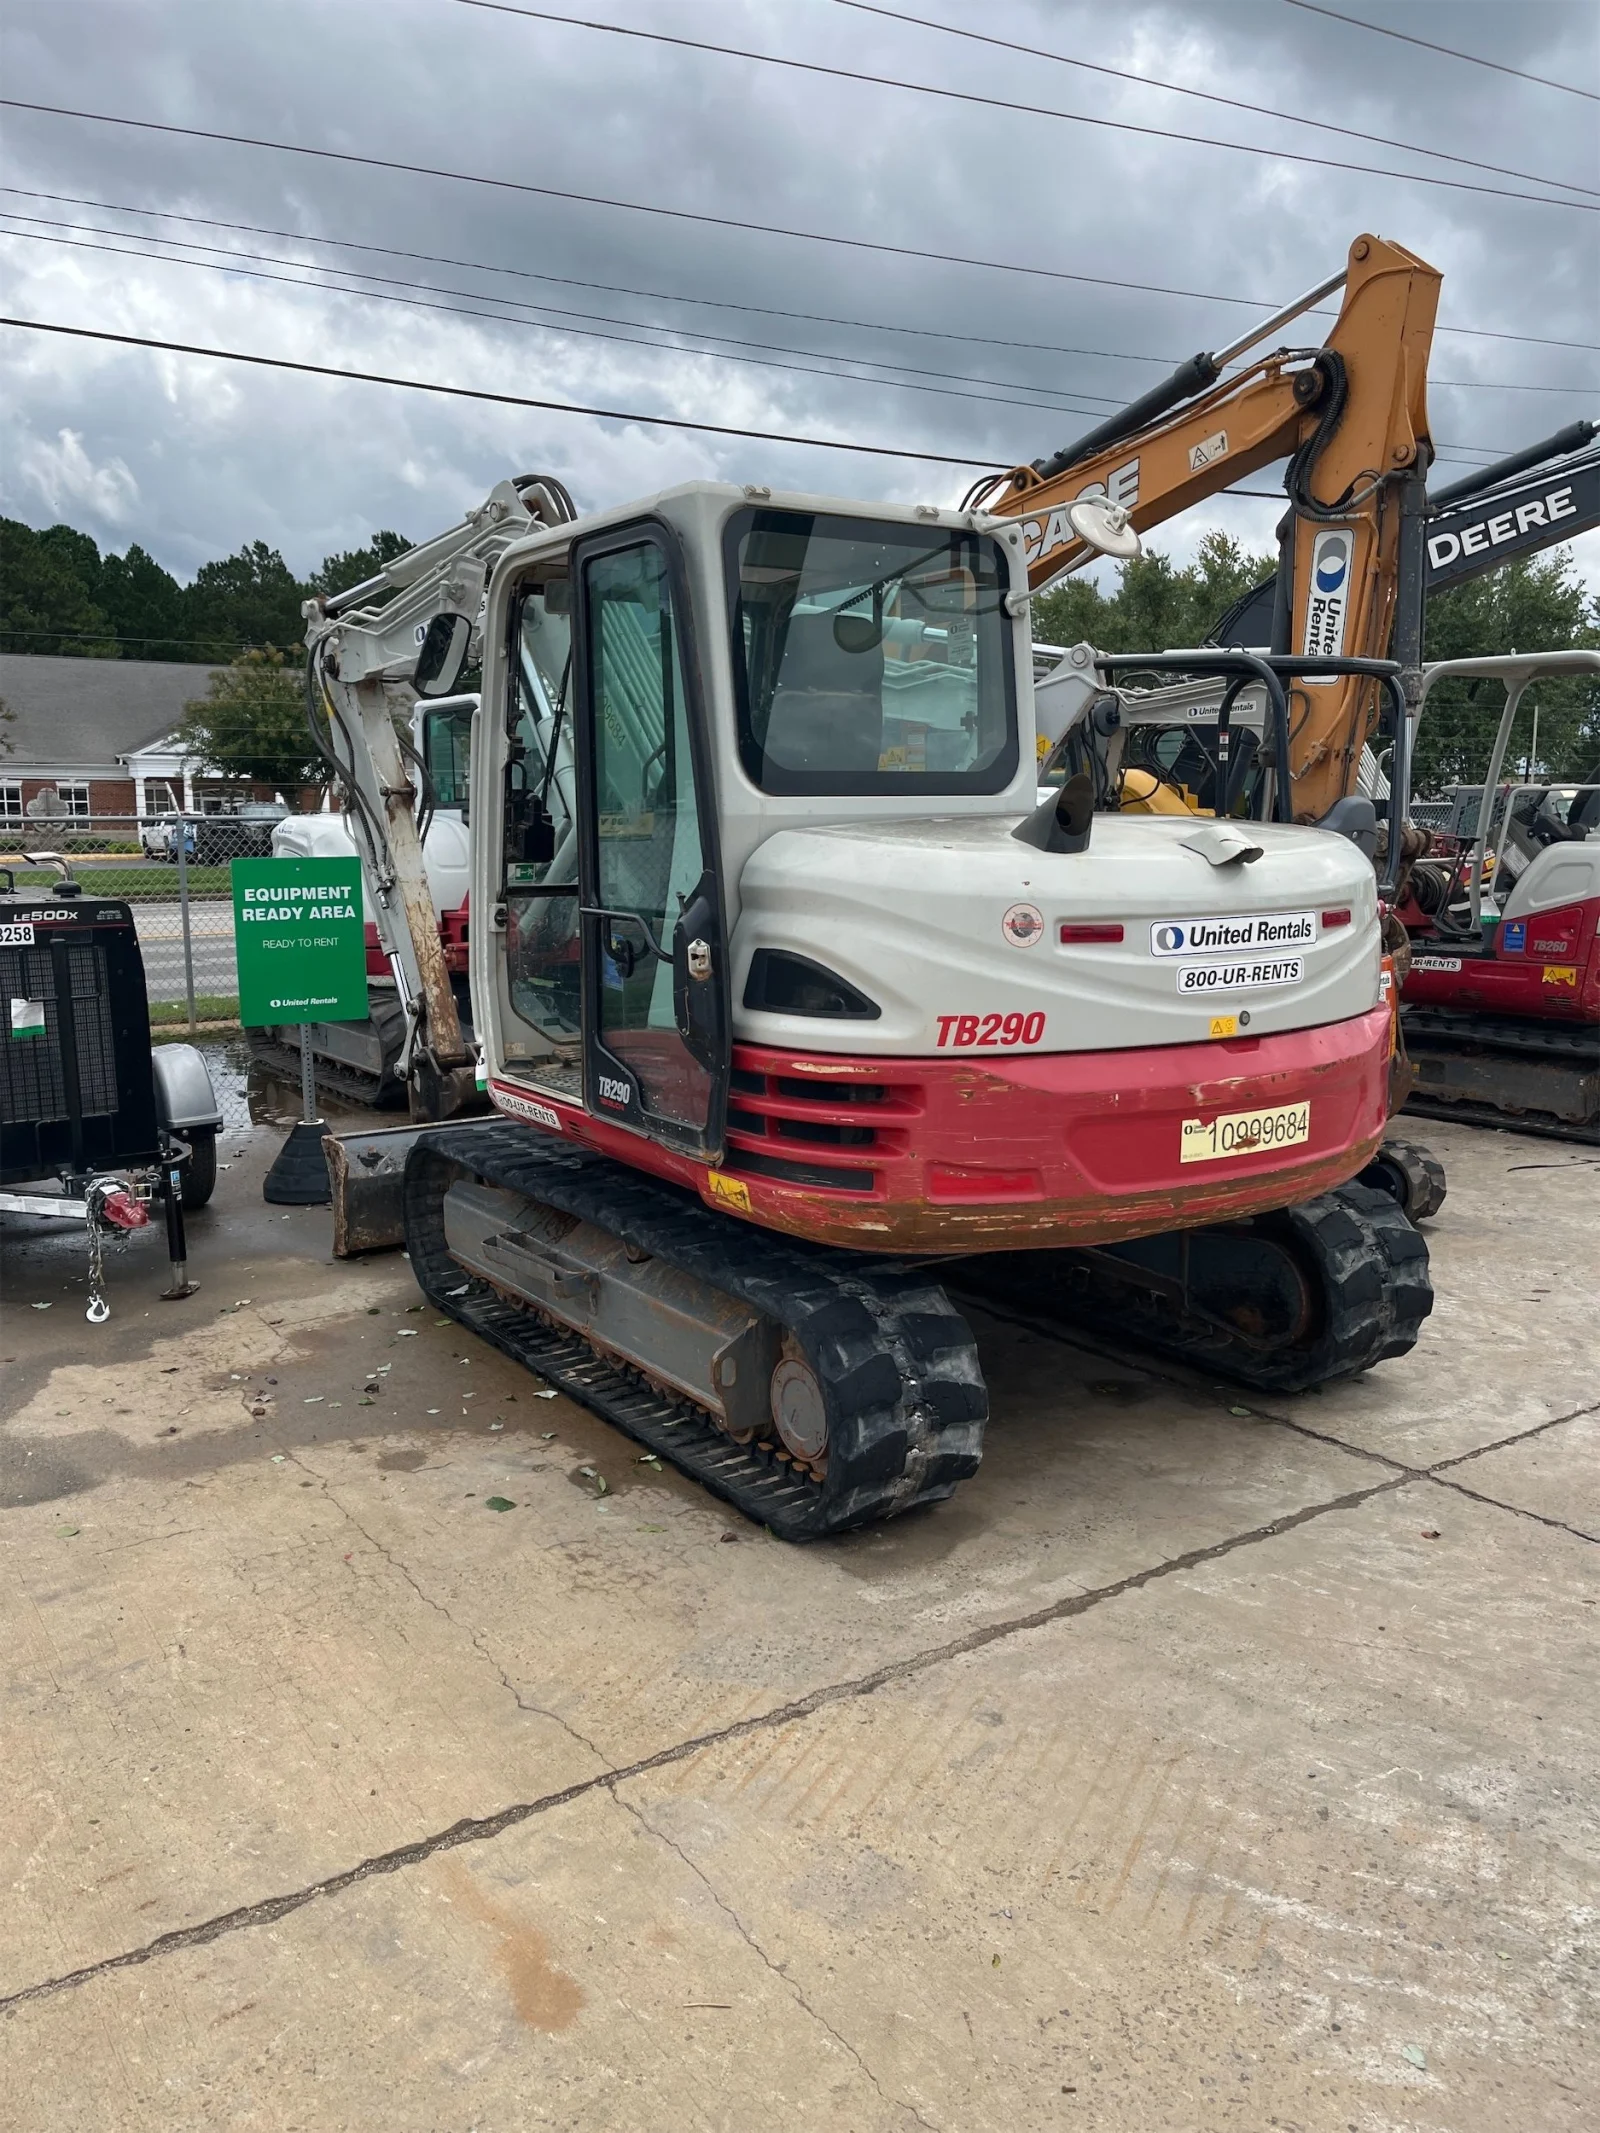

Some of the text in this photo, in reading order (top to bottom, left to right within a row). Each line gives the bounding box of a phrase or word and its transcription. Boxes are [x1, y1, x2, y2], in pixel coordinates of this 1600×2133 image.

[1022, 456, 1140, 567] CAE
[1427, 486, 1577, 570] DEERE
[1308, 597, 1327, 656] Renta
[1322, 597, 1342, 656] Unite
[1199, 702, 1254, 716] Unite entals
[244, 886, 352, 902] EQUIPMENT
[242, 905, 356, 922] READY AREA
[262, 936, 339, 949] READY TO RENT
[1189, 918, 1312, 947] United Rentals
[1533, 939, 1568, 953] TB260
[1184, 962, 1299, 988] 800-UR-RENTS
[282, 997, 338, 1007] United Rentals
[936, 1011, 1046, 1047] TB290
[598, 1075, 631, 1104] TB290
[1208, 1108, 1307, 1153] 10999684
